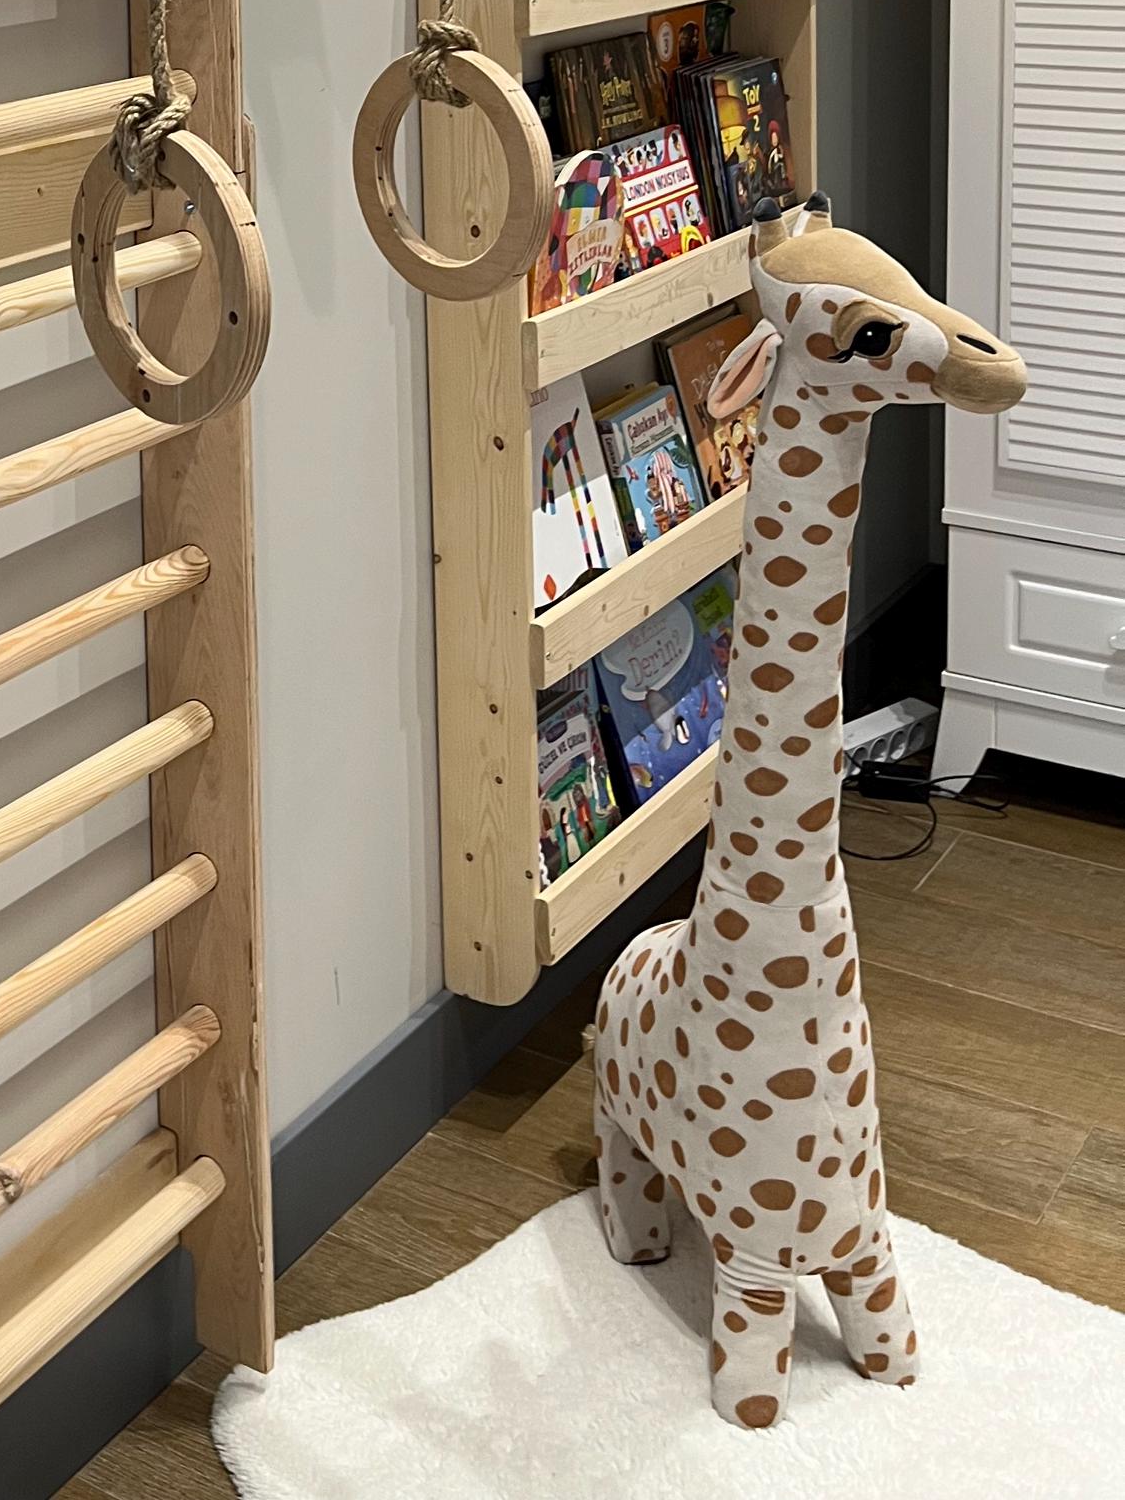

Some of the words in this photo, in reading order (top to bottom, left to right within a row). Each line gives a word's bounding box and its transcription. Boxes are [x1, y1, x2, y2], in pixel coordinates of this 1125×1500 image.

[742, 84, 761, 106] TOY
[753, 114, 761, 132] 2
[626, 177, 657, 202] LONDON
[656, 172, 678, 191] NOISY
[677, 166, 691, 185] BUS
[628, 629, 683, 688] Derin?
